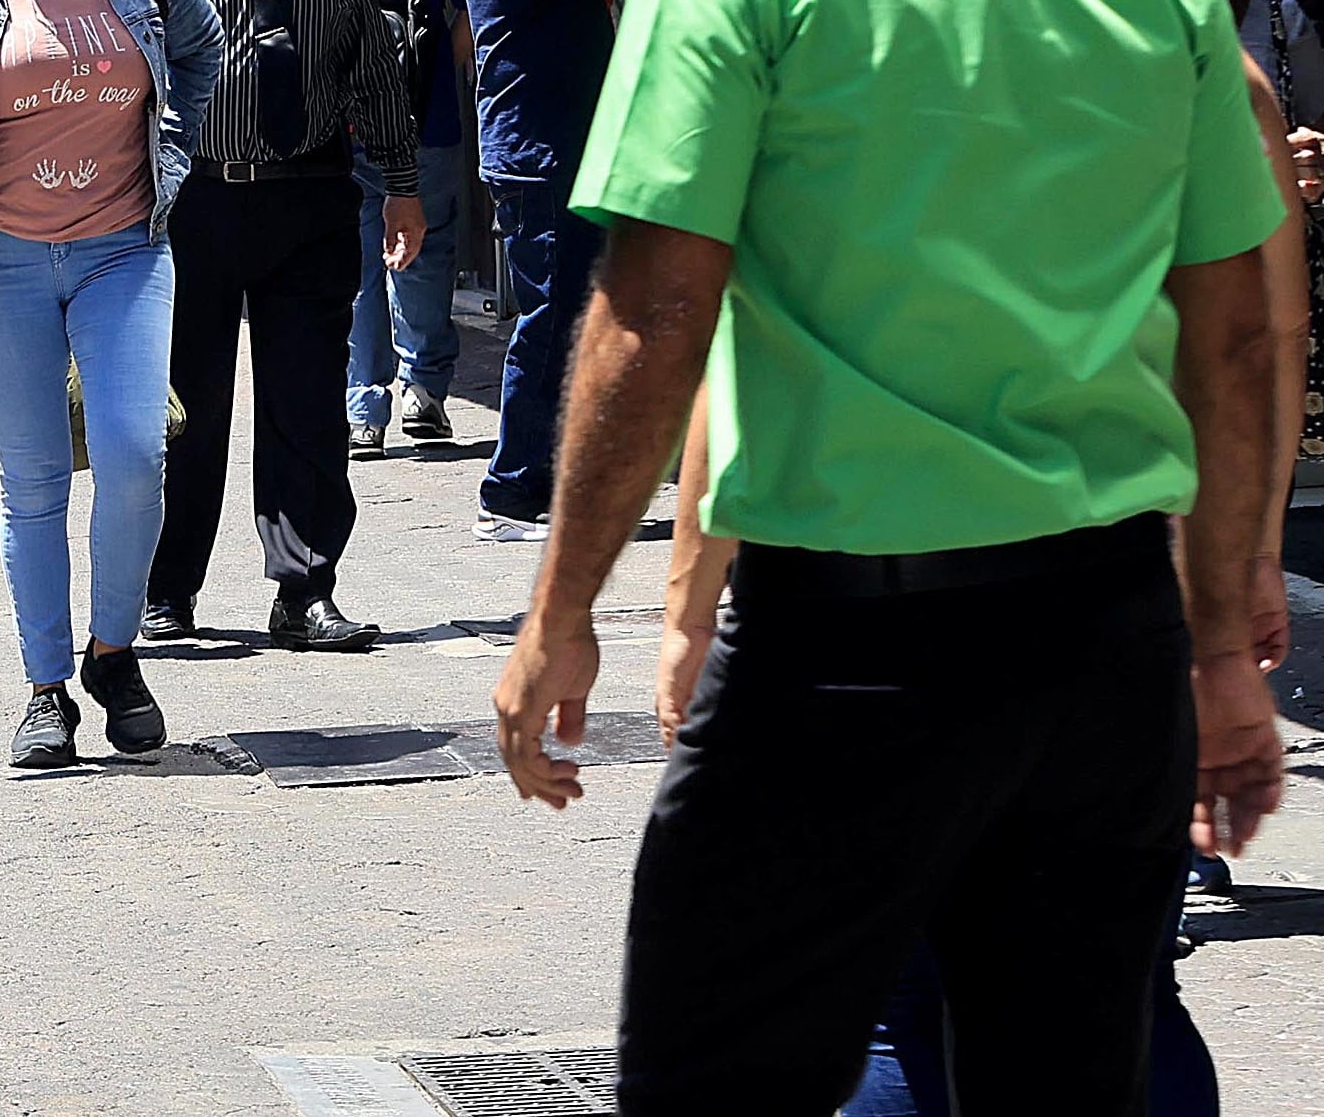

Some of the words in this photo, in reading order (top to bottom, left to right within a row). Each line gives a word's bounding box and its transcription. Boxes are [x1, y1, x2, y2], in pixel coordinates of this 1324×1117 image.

[71, 59, 91, 77] is
[13, 93, 41, 112] on
[42, 78, 90, 103] the
[98, 86, 141, 111] way
